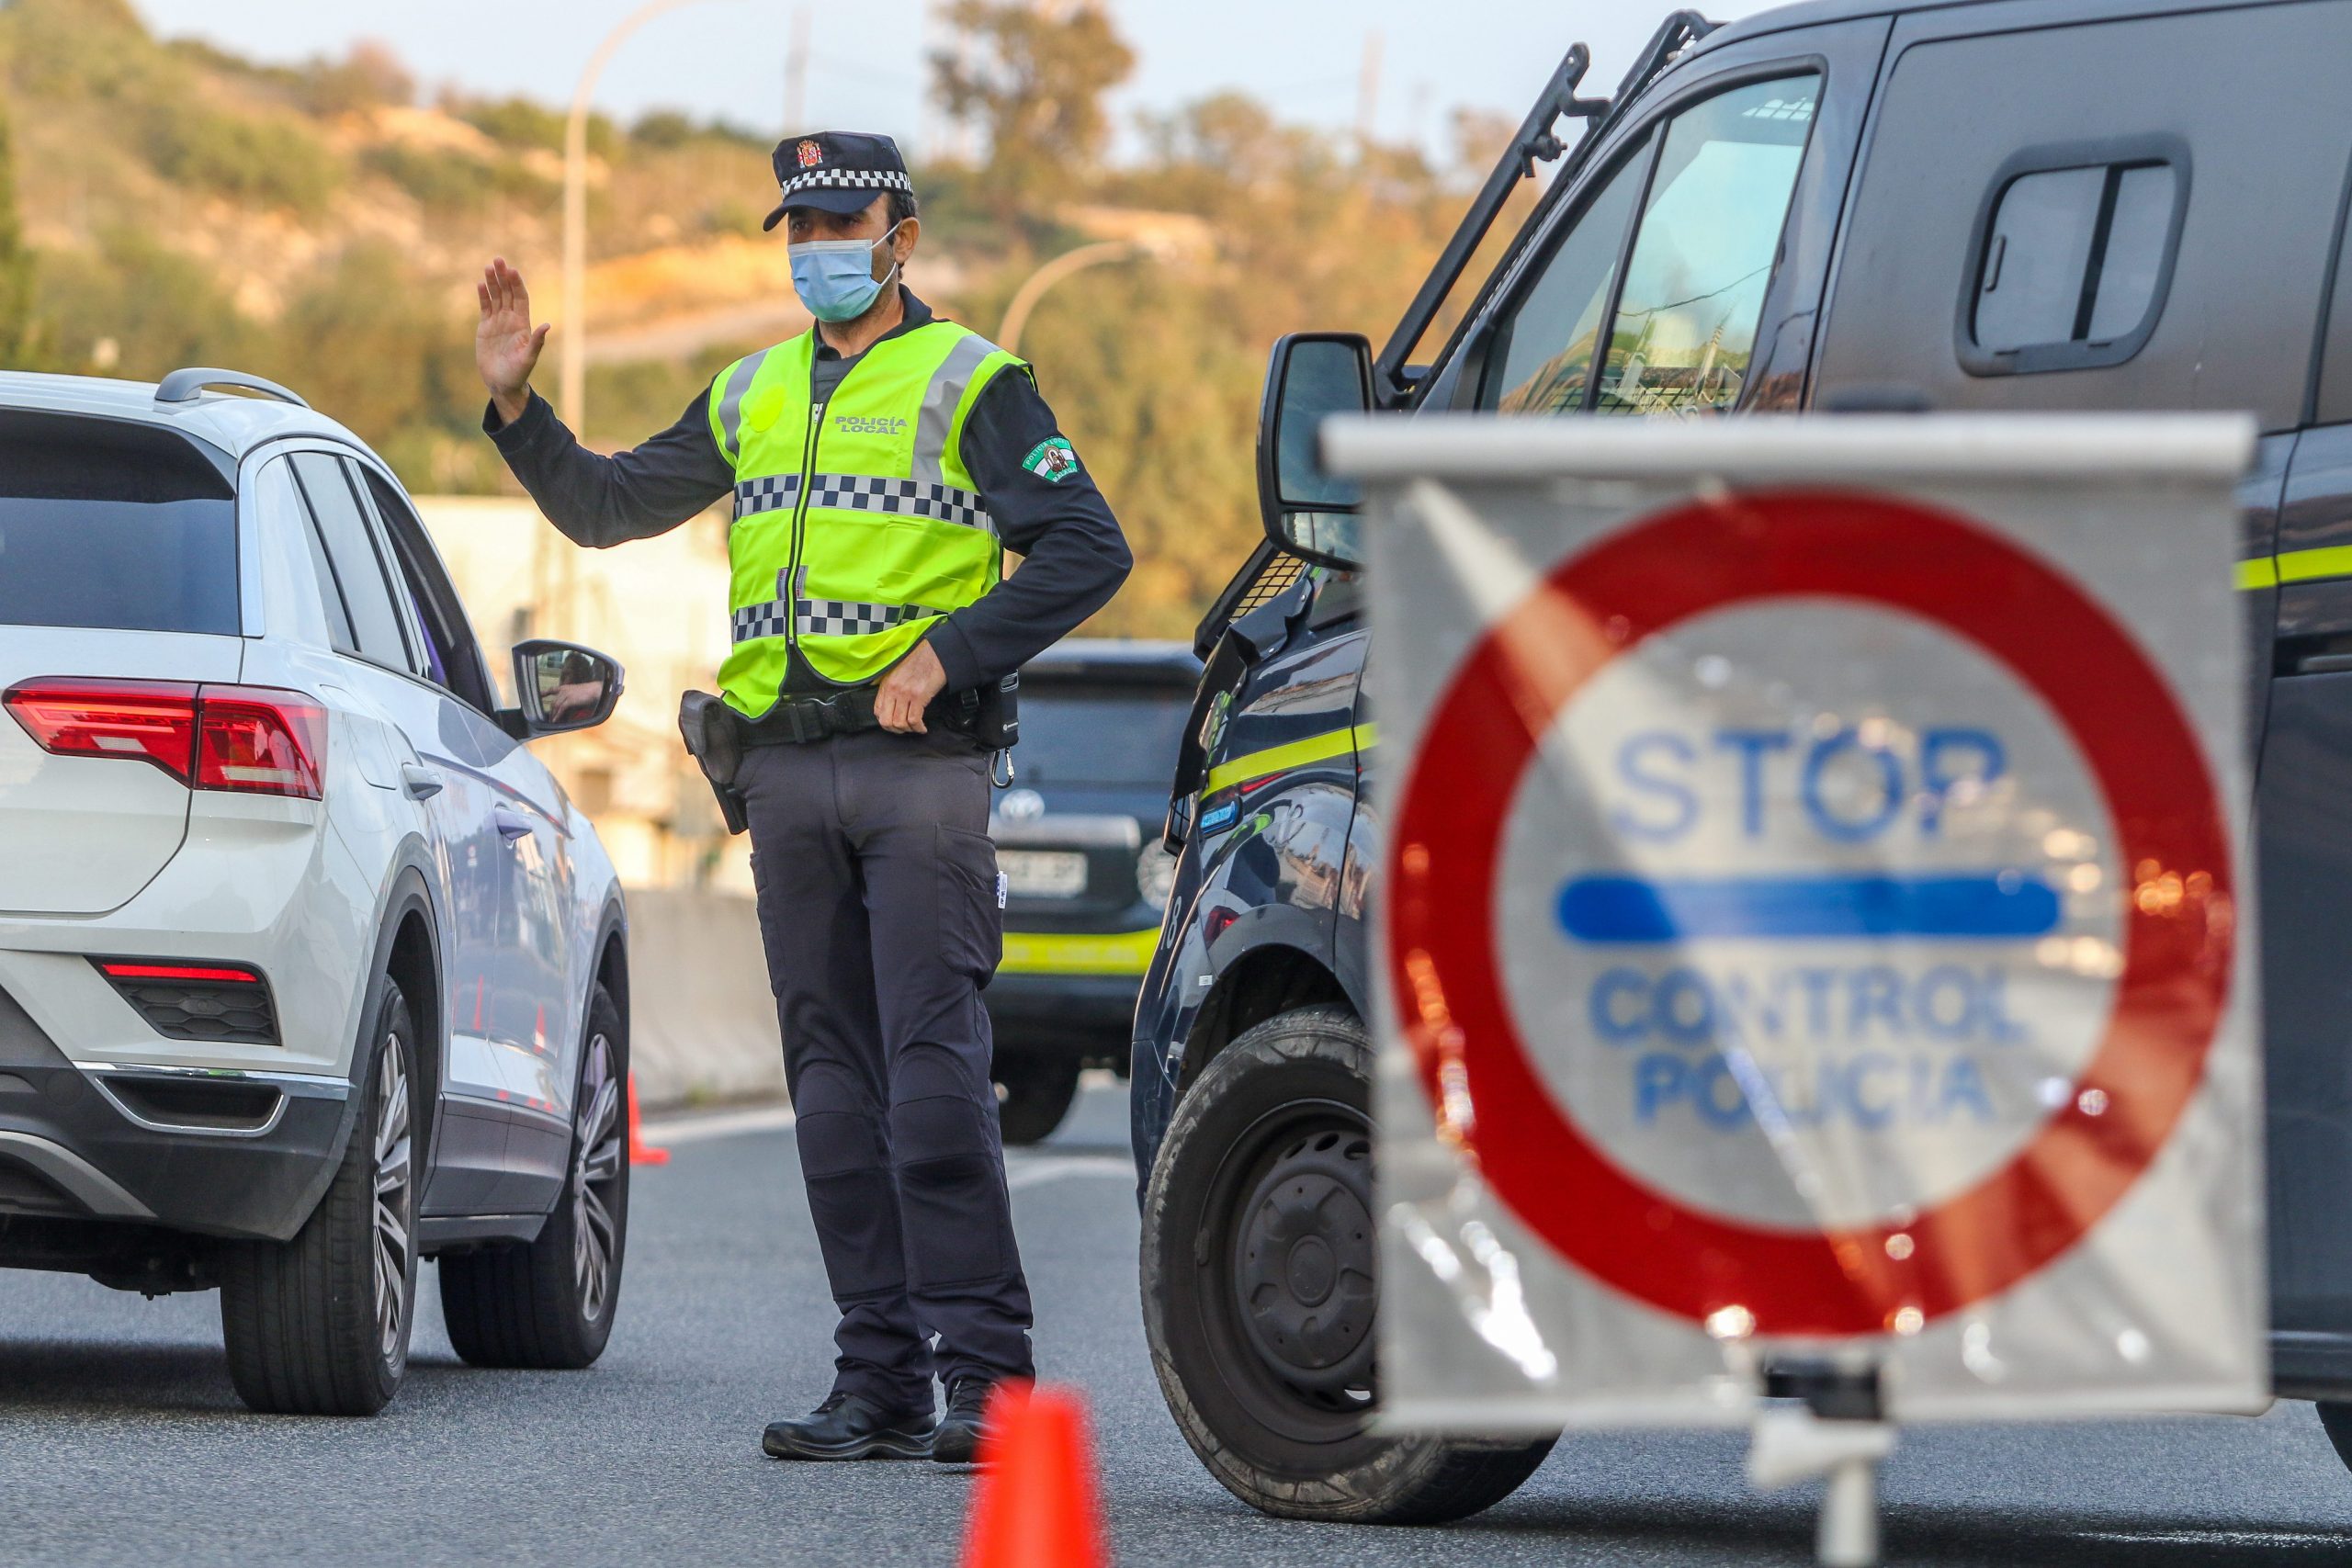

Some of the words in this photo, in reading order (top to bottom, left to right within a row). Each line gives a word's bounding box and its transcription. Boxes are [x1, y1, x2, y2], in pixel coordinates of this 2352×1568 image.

[842, 424, 899, 434] LOCAL
[1613, 725, 2009, 842] STOP
[1589, 958, 2032, 1045] CONTROL
[1634, 1051, 1998, 1132] POLICIA
